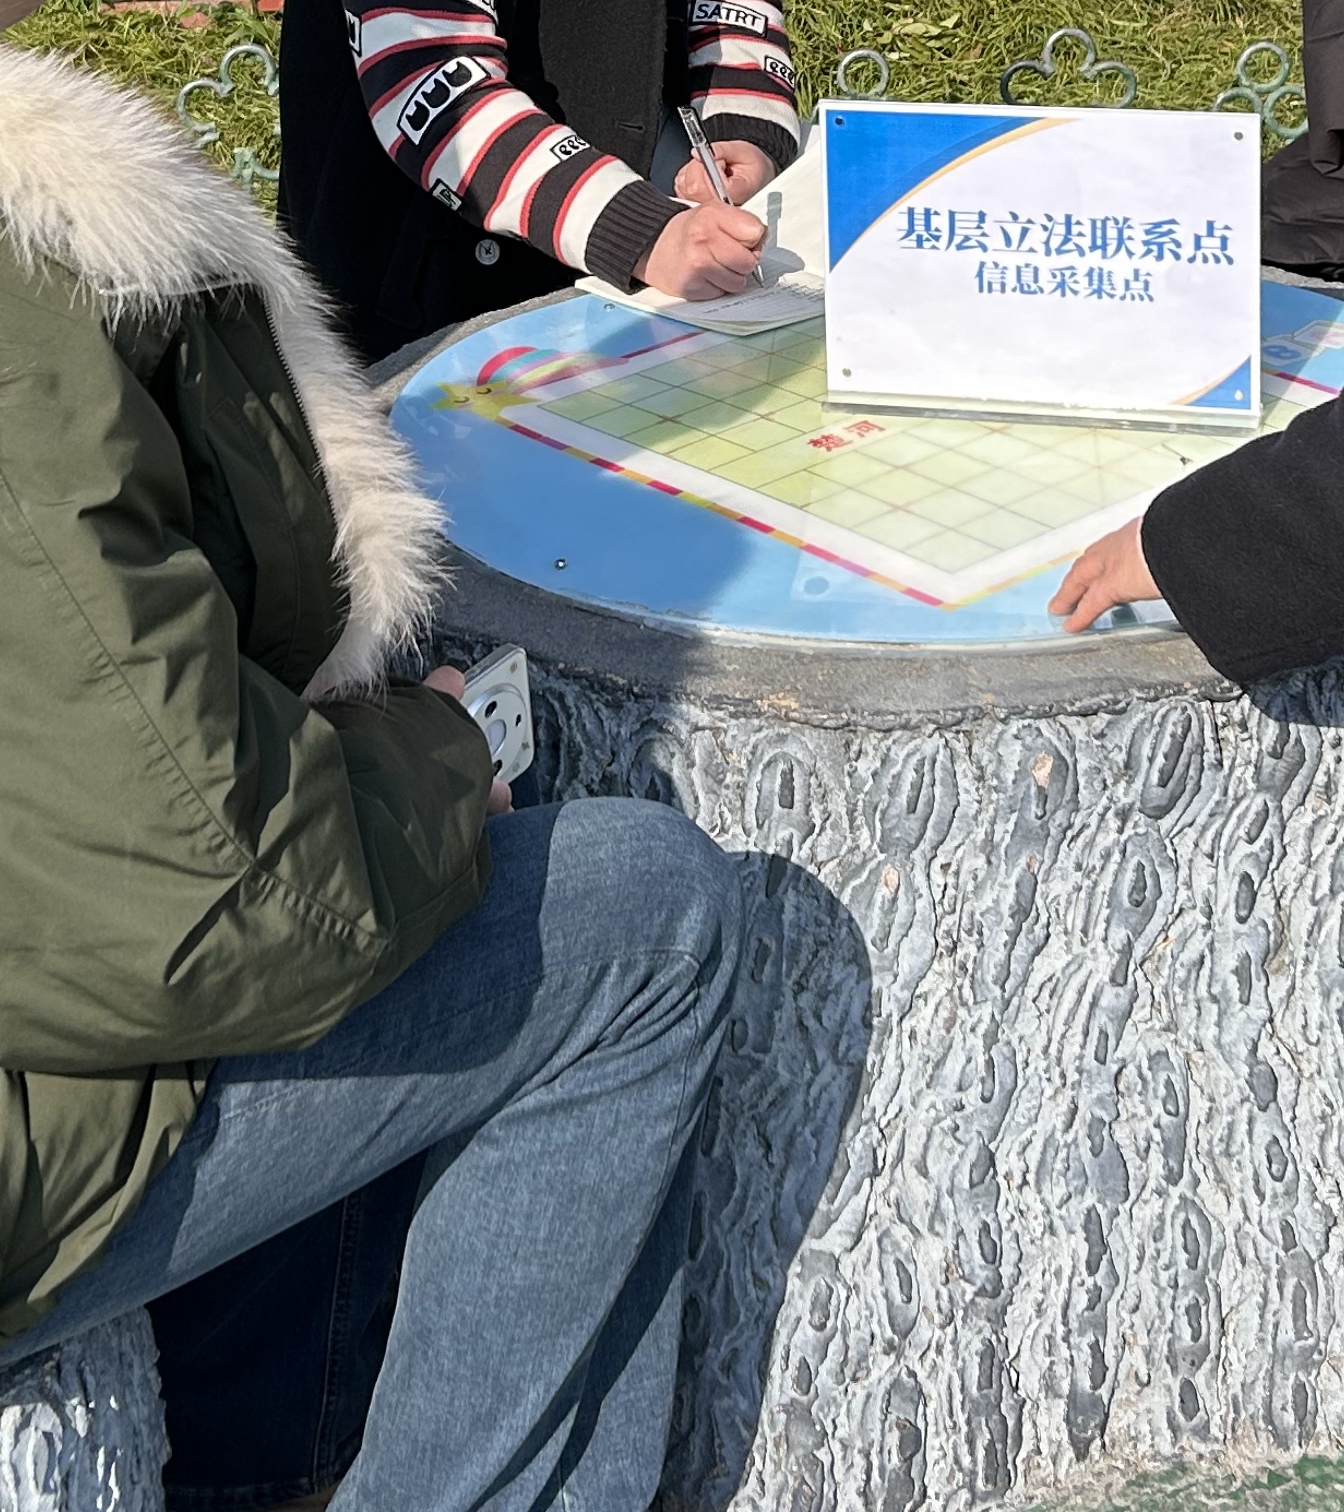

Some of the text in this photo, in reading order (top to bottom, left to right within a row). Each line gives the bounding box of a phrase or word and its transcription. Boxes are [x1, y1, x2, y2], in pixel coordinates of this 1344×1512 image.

[695, 2, 764, 30] SATRT
[897, 206, 1235, 266] 基层立法联系点
[974, 259, 1156, 303] 信息采集点
[806, 419, 886, 453] 楚河
